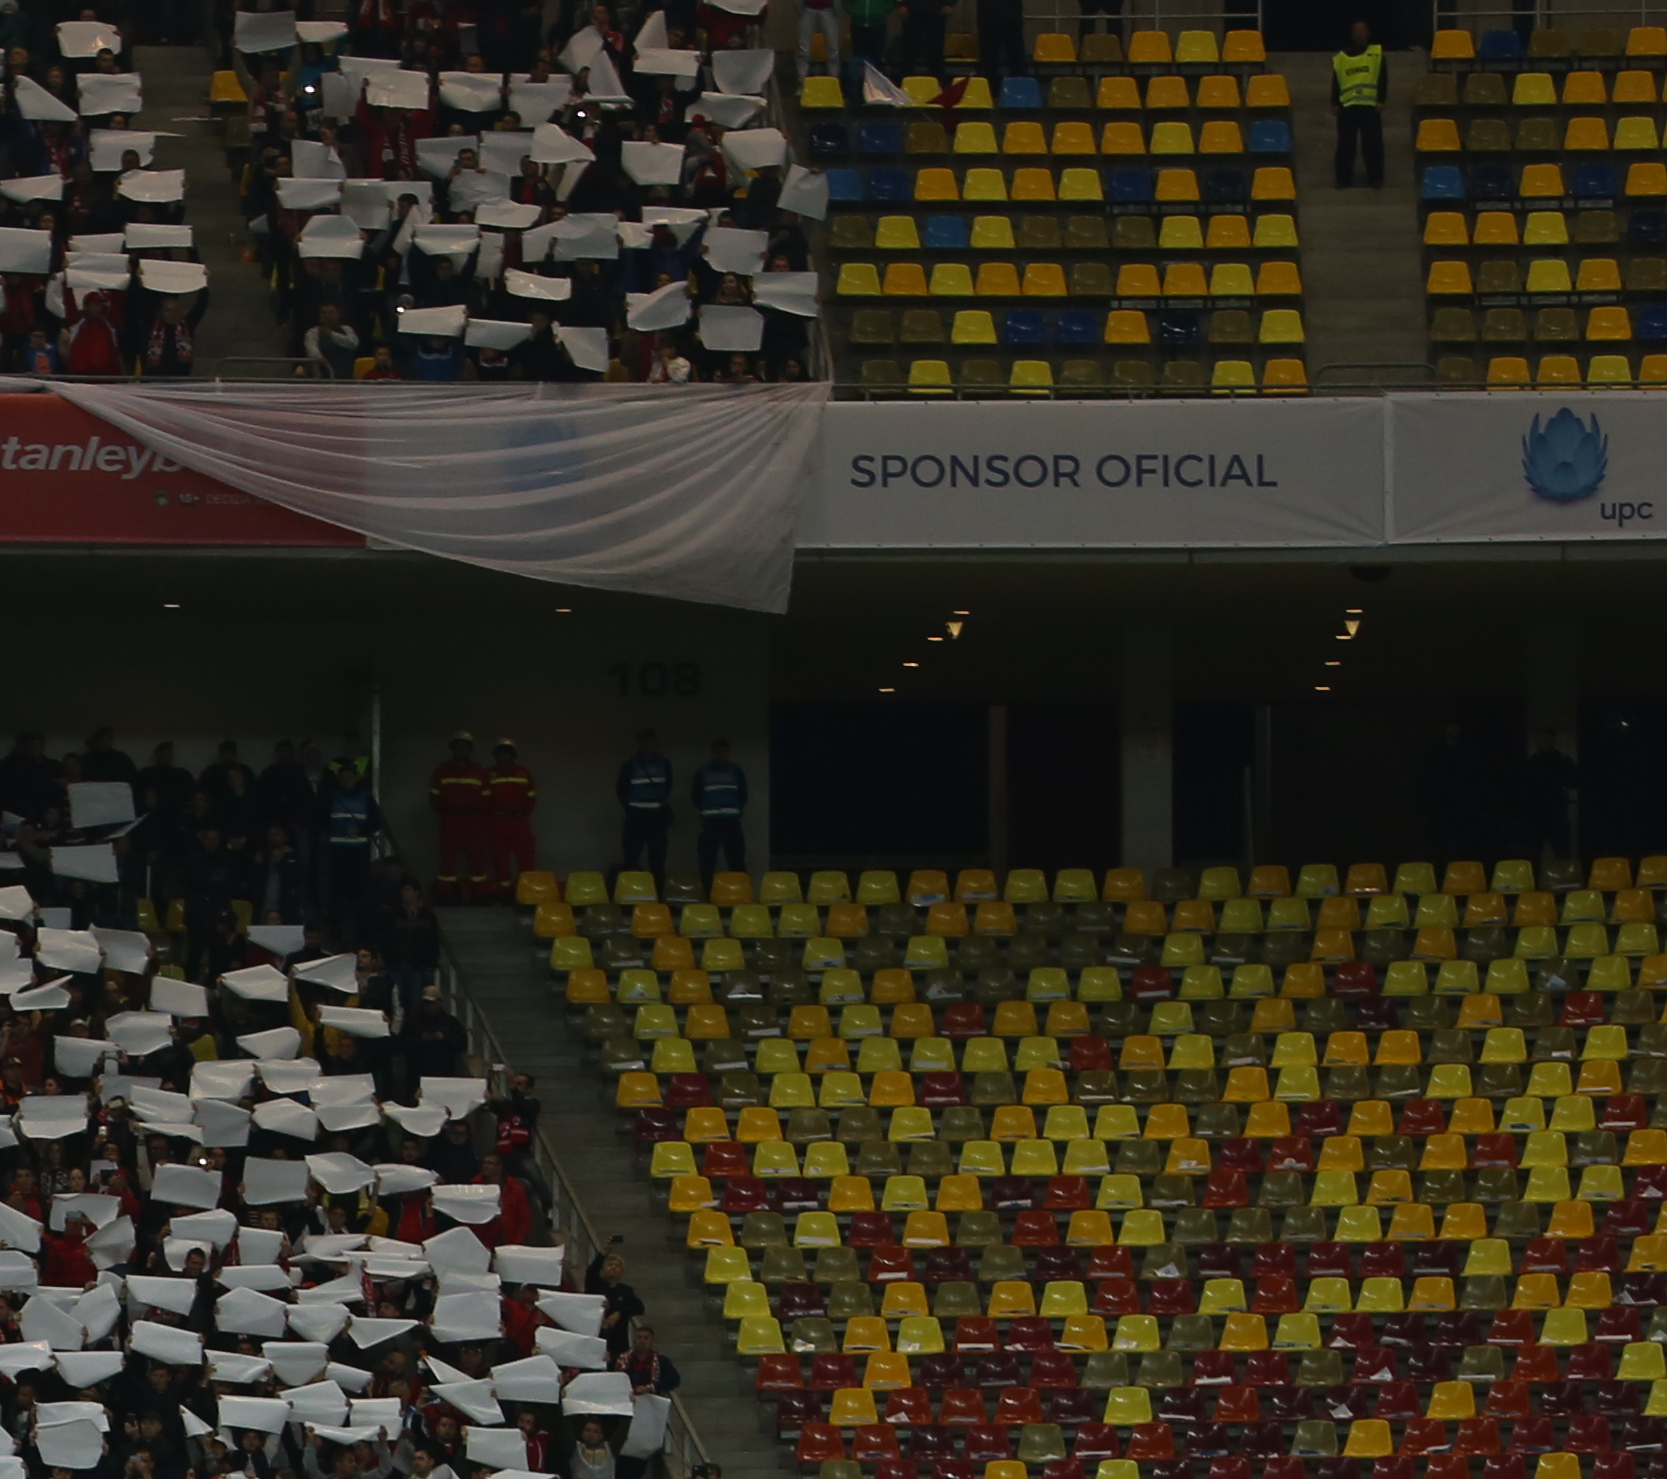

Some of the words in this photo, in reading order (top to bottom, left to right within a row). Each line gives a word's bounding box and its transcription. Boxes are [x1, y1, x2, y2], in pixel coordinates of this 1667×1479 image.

[849, 453, 1082, 489] SPONSOR
[1095, 453, 1279, 489] OFICIAL
[1599, 496, 1654, 523] upc
[606, 661, 702, 698] 108
